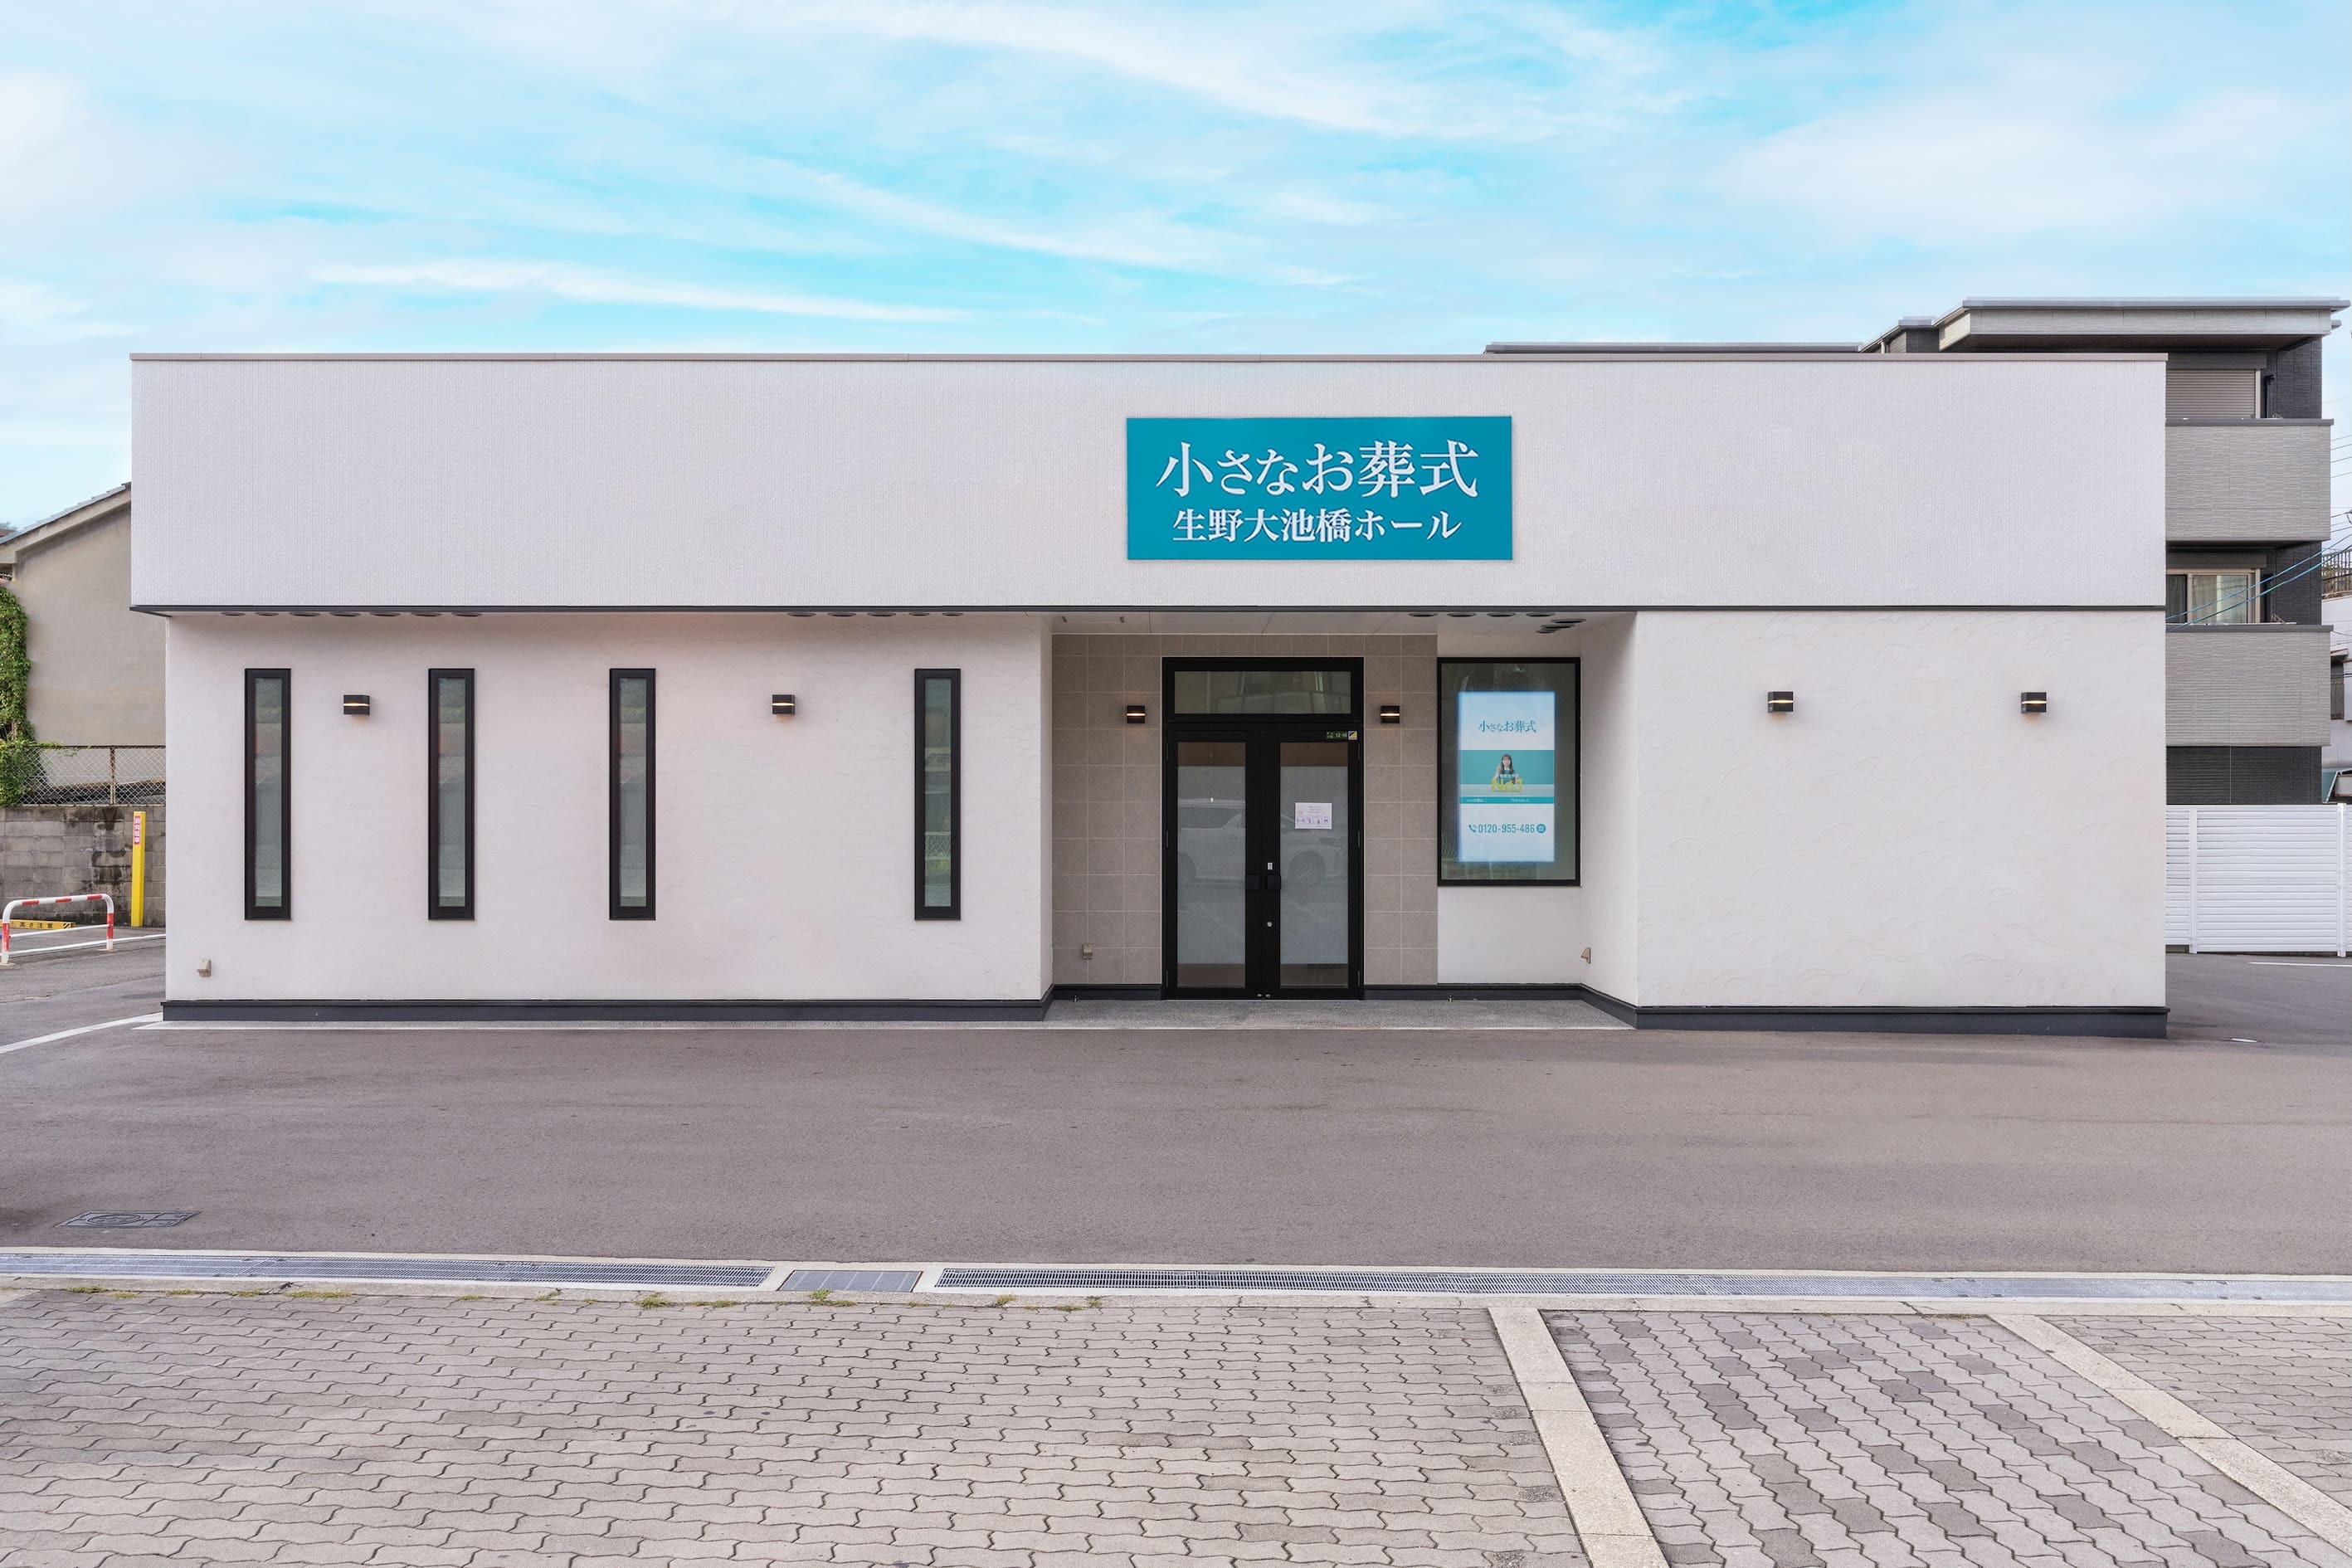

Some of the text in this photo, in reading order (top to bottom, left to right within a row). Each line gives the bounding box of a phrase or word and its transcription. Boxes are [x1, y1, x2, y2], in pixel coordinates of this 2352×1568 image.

[1156, 439, 1479, 498] 小さなお葬式
[1172, 508, 1463, 543] 生野大池橋ホール
[1478, 720, 1536, 733] 小さなお葬式
[1491, 778, 1523, 792] No.1
[1478, 824, 1535, 833] 0120-955-486
